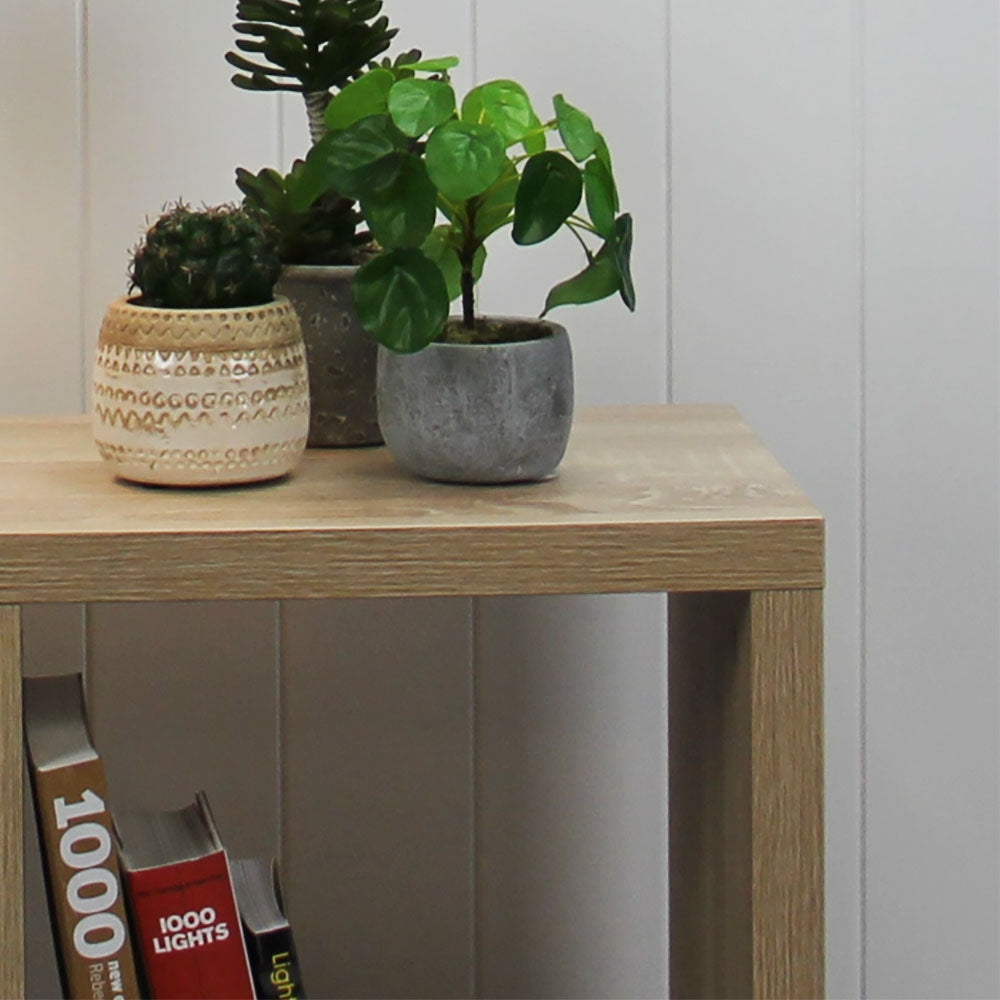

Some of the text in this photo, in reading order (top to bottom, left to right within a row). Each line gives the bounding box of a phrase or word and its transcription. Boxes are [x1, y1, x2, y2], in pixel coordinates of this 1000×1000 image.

[53, 789, 126, 959] 1000
[158, 907, 216, 934] 1000
[153, 922, 230, 954] LIGHTS
[108, 960, 122, 992] new
[271, 952, 297, 1000] Ligh
